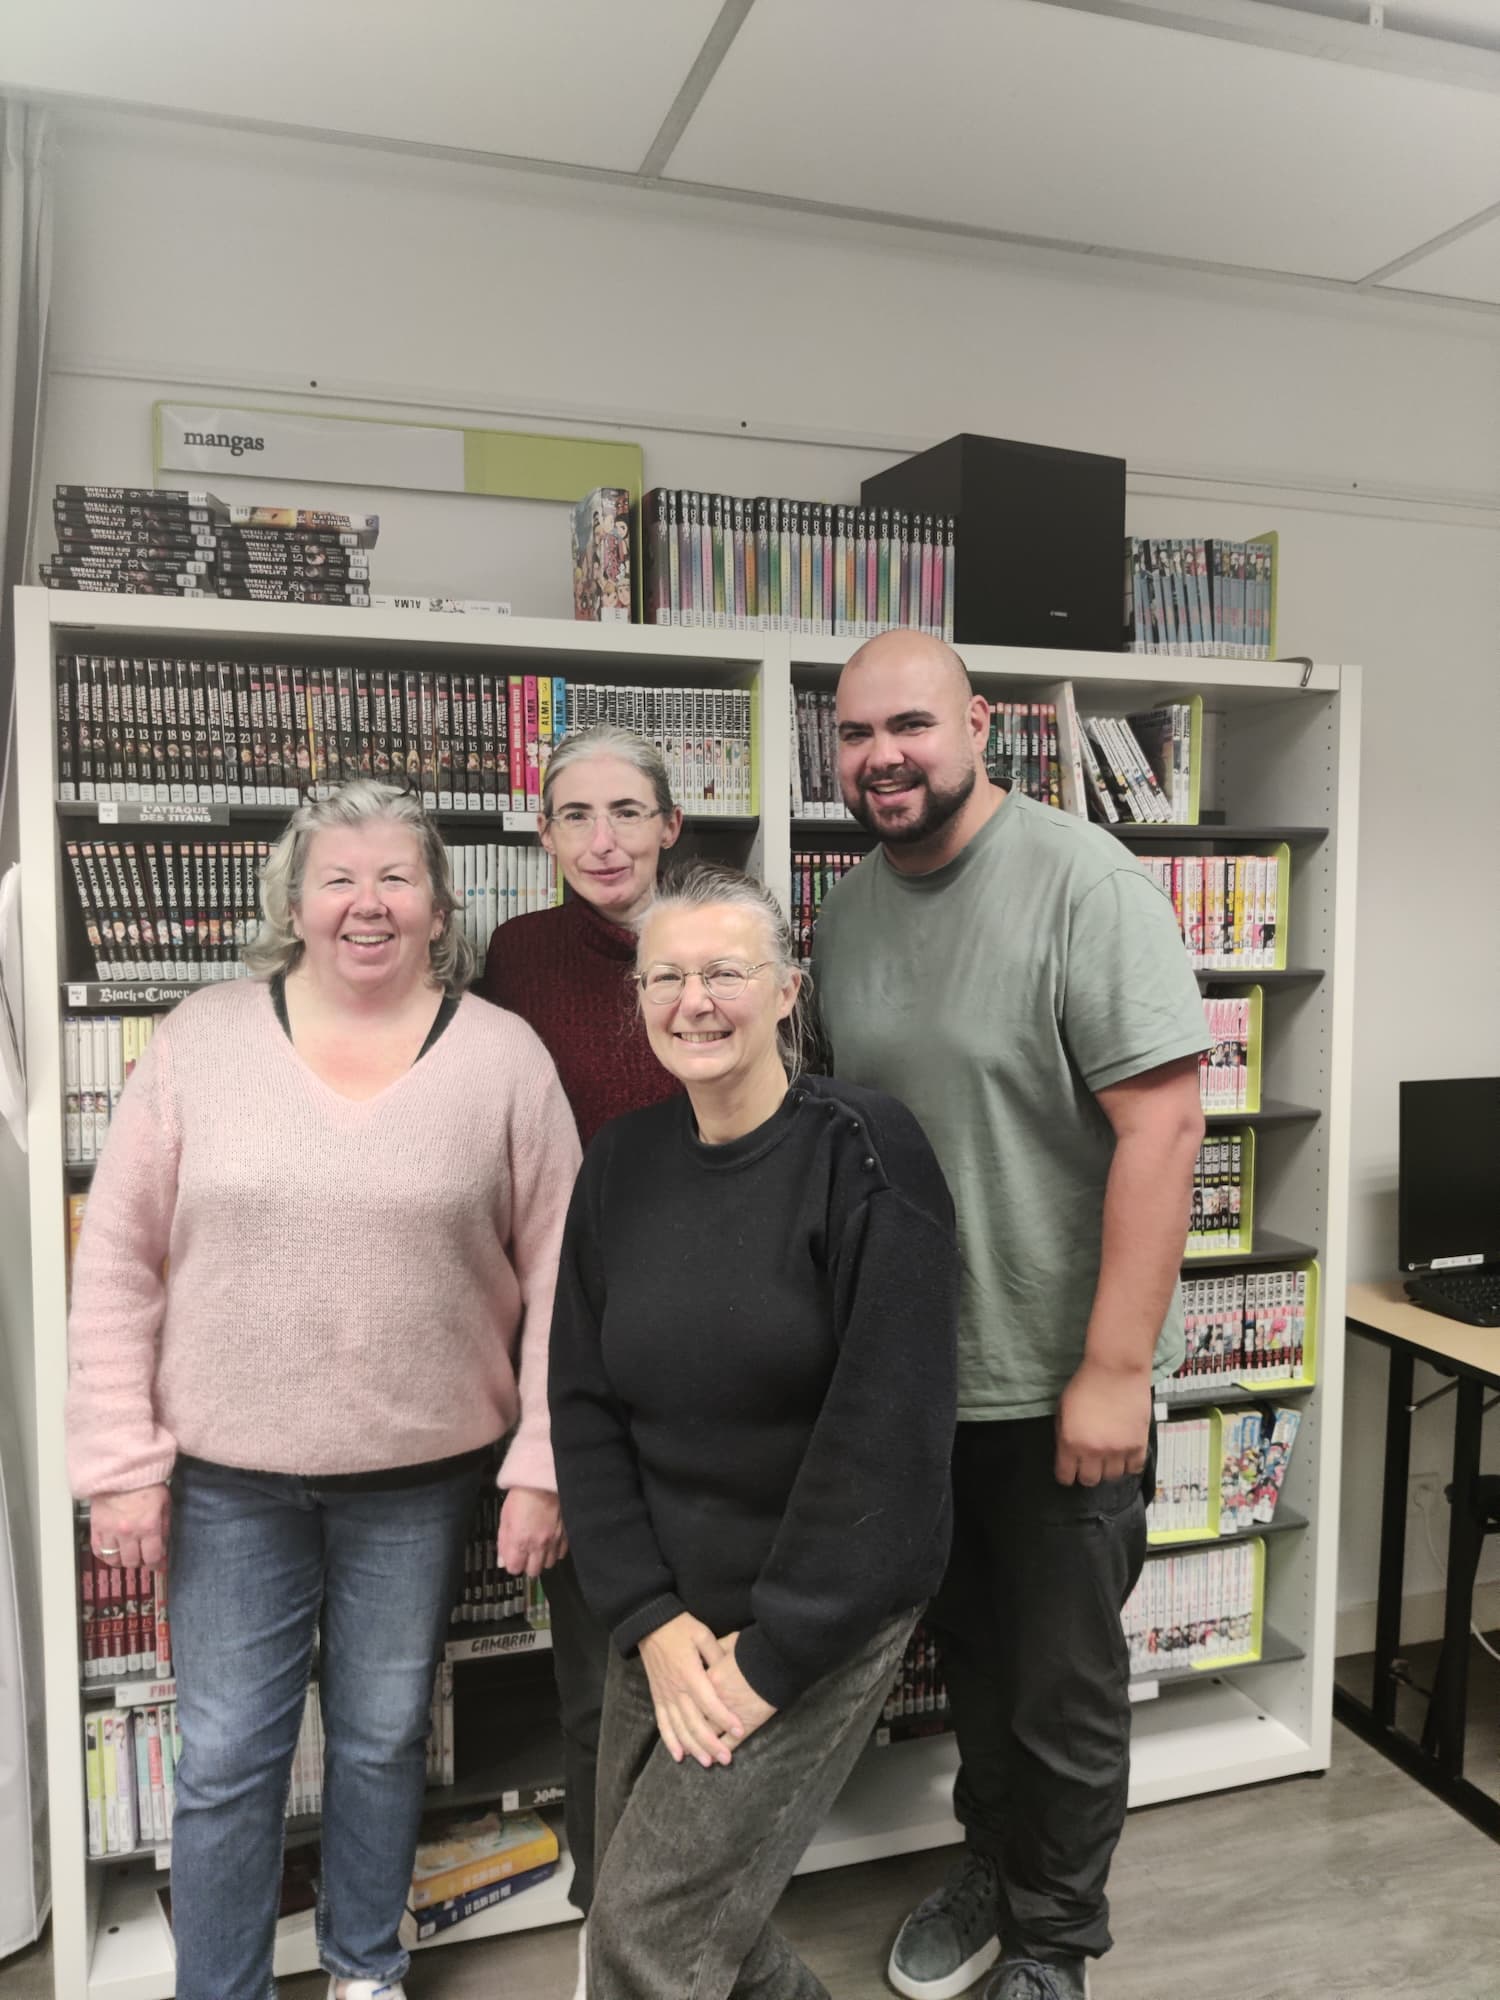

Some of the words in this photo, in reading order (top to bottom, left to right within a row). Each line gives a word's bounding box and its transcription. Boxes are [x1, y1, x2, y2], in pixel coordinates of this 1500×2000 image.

[184, 432, 265, 456] mangas
[394, 600, 421, 609] ALMA
[556, 700, 564, 726] ALMA
[142, 805, 208, 814] L'ATTAQUE
[168, 814, 211, 822] TITANS
[99, 987, 136, 1003] Black
[145, 987, 190, 1002] Clover
